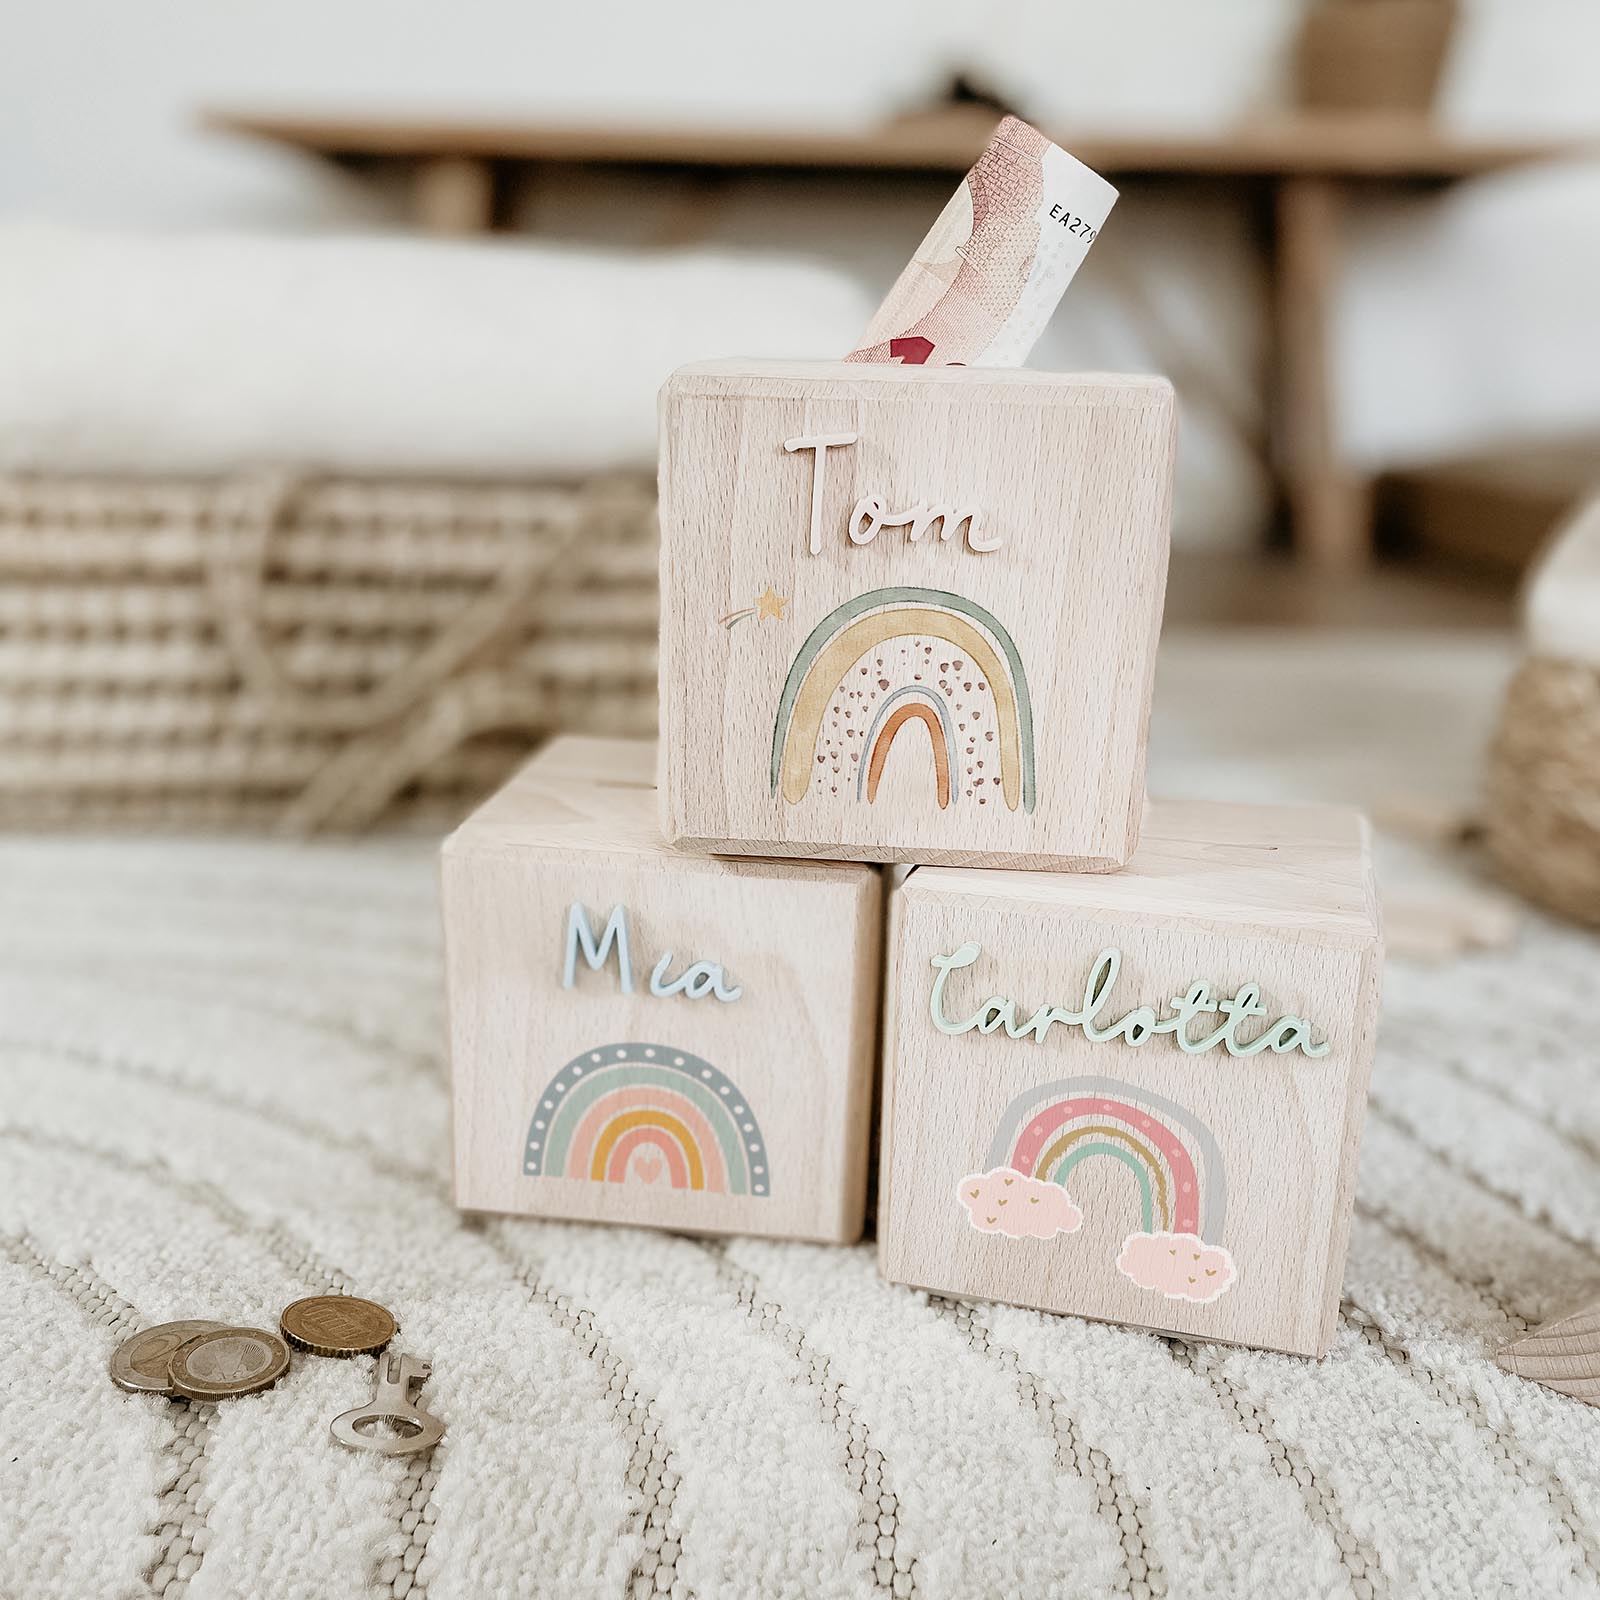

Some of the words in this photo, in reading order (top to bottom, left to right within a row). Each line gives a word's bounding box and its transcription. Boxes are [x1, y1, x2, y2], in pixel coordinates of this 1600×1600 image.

[1049, 203, 1096, 244] EA279
[784, 432, 1004, 556] Tom
[563, 901, 743, 1003] Mia
[929, 941, 1331, 1058] Carlotta
